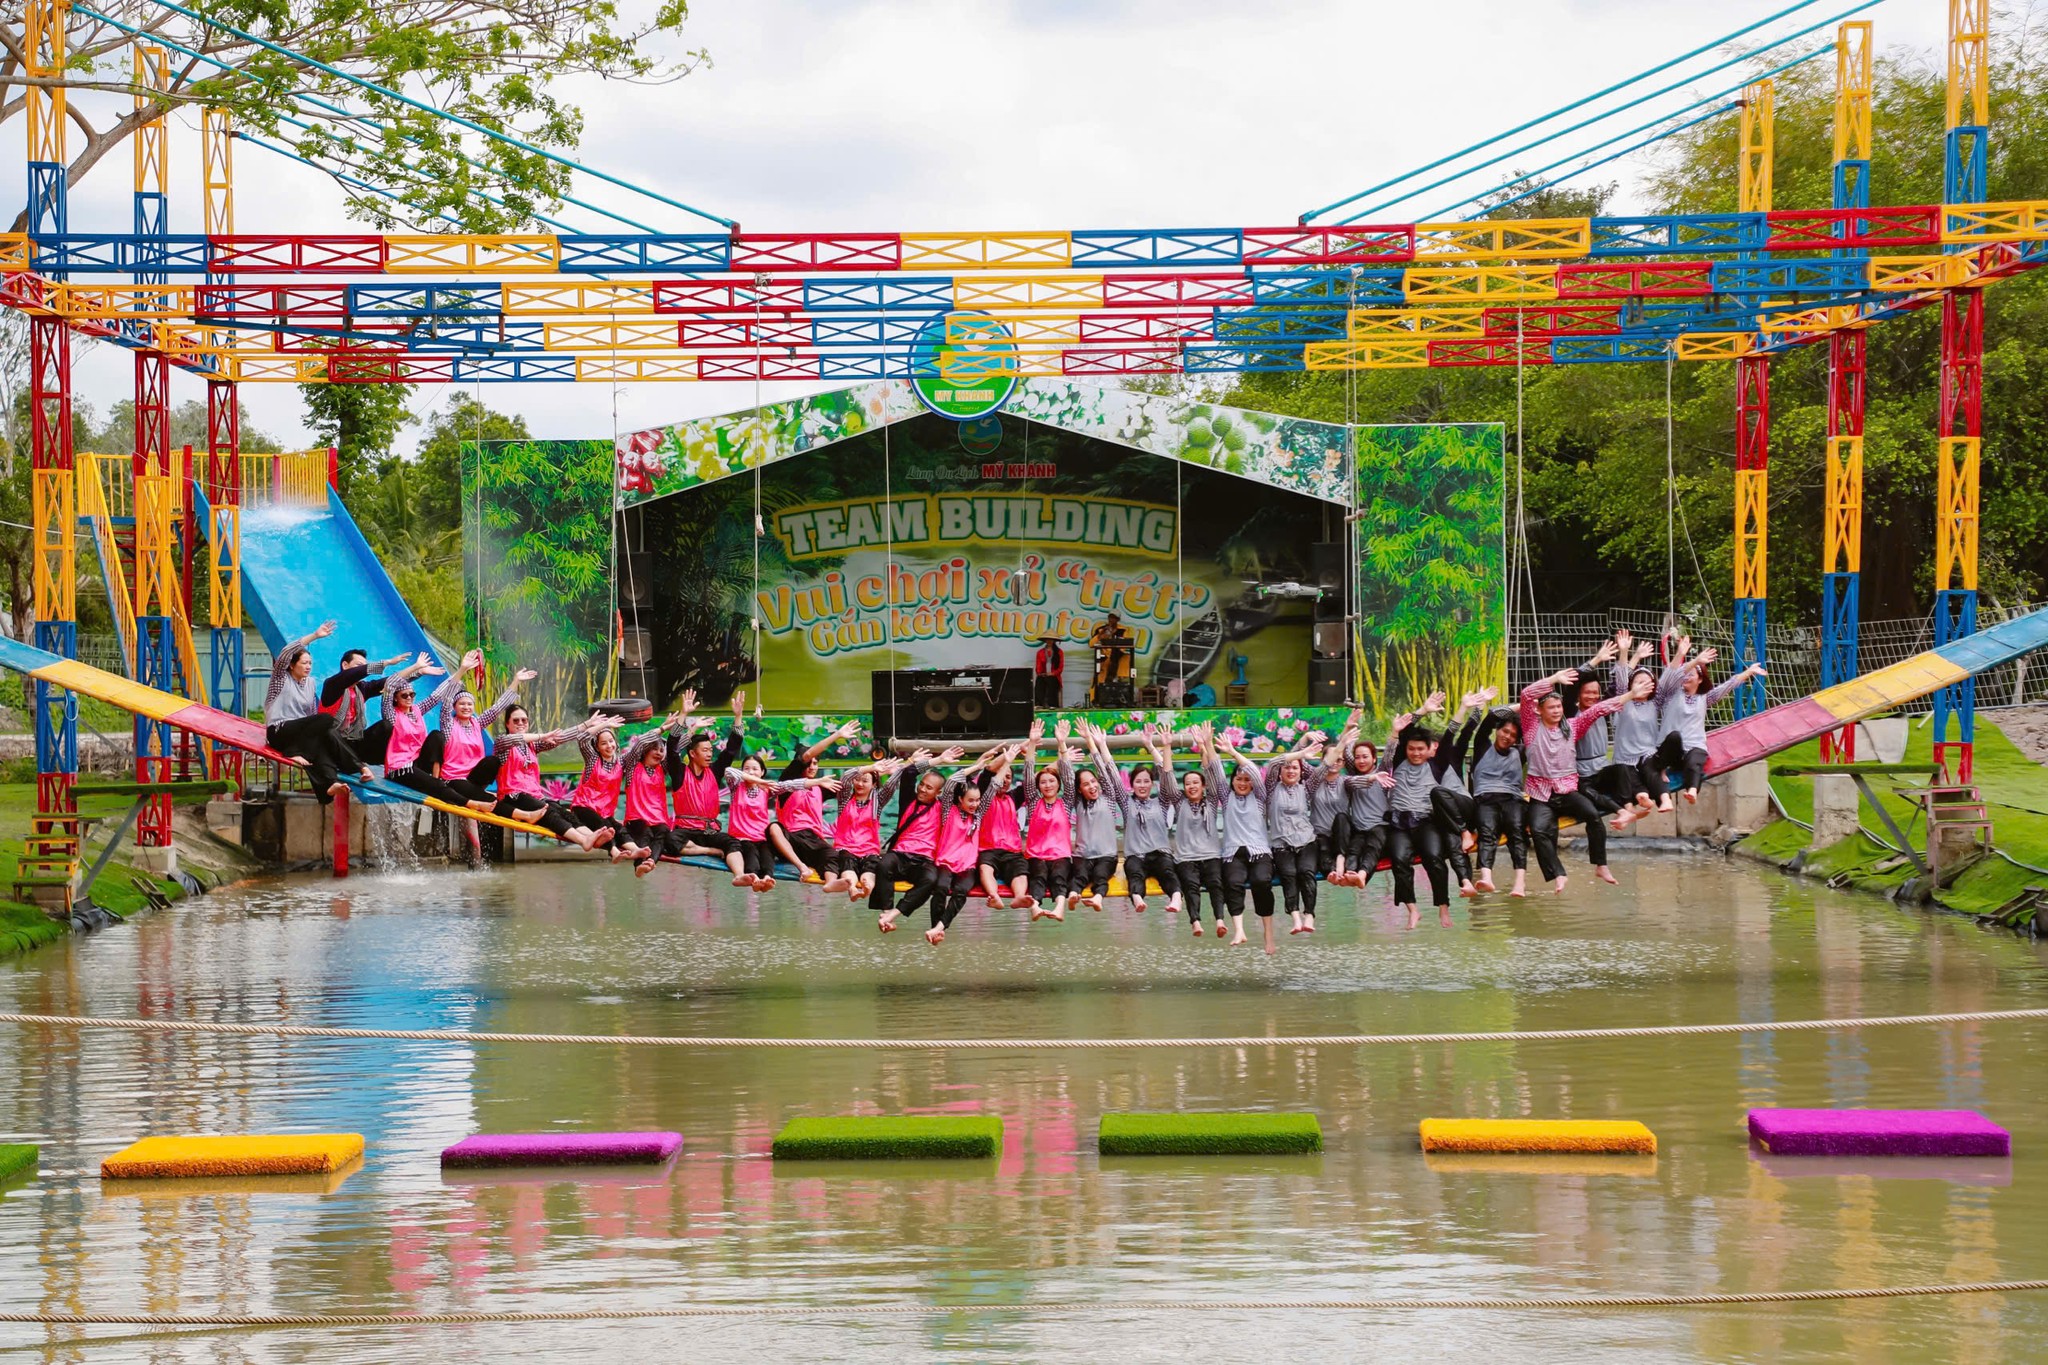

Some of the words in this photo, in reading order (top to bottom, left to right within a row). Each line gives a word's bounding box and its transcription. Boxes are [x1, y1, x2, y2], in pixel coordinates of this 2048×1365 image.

[982, 461, 1004, 479] MỸ
[1007, 459, 1056, 479] KHÁNH
[779, 499, 929, 555] TEAM
[938, 496, 1176, 554] BUILDING
[757, 572, 846, 631] Vui
[856, 558, 968, 609] chơi
[811, 607, 884, 653] Gắn
[889, 598, 951, 640] kết
[957, 602, 1049, 644] cùng
